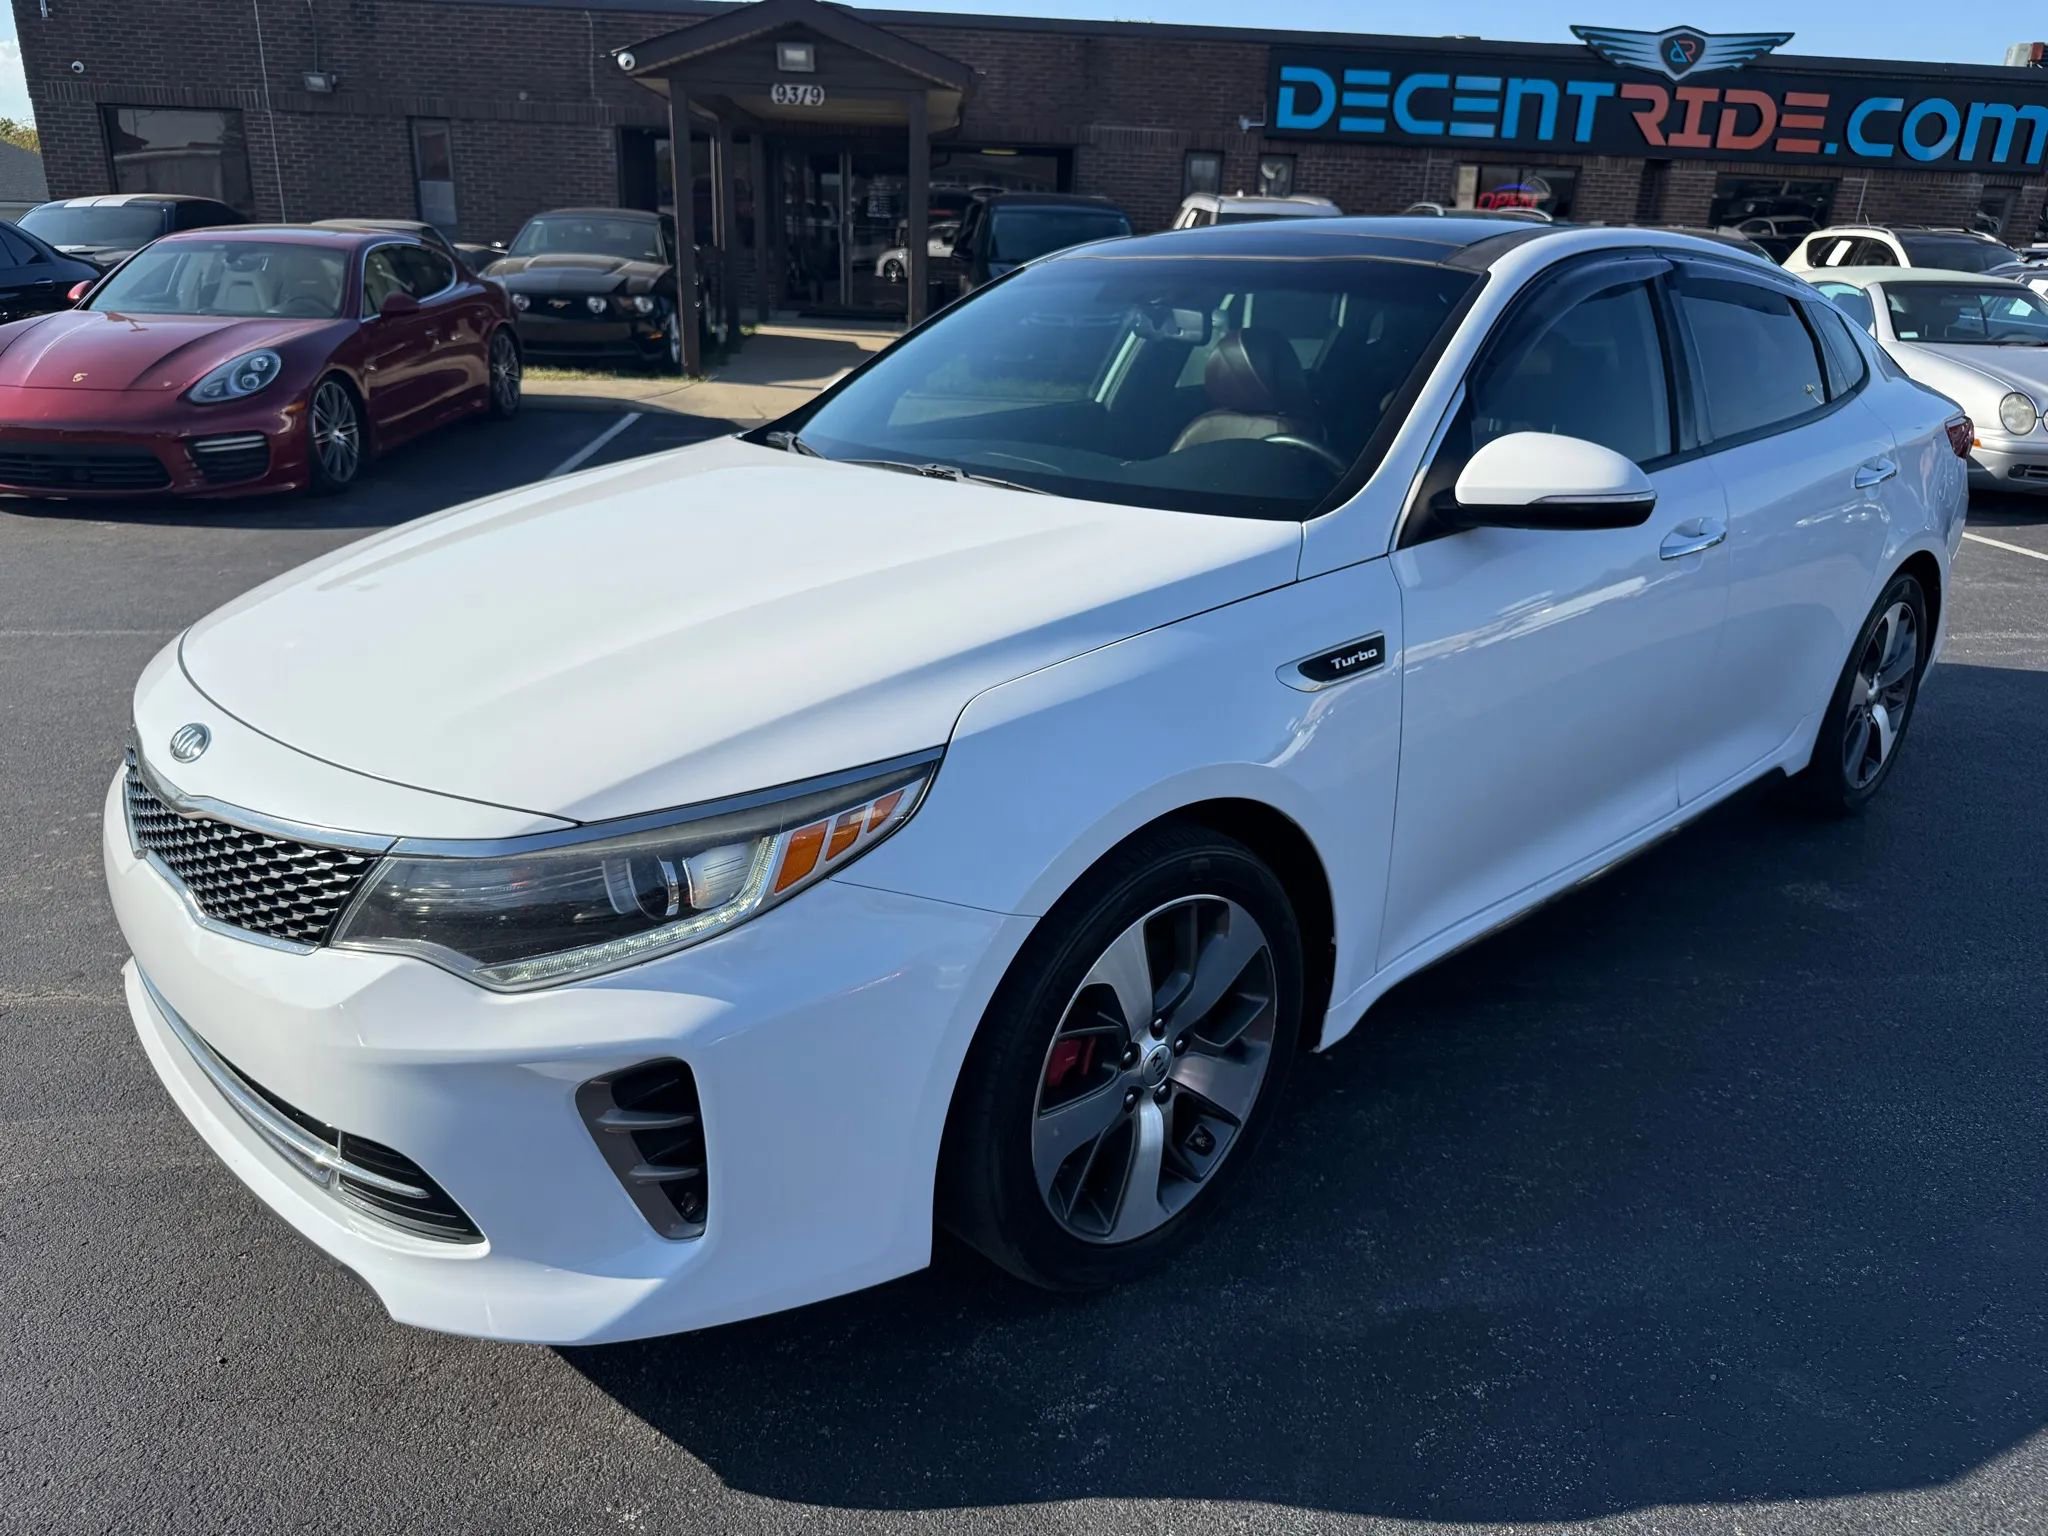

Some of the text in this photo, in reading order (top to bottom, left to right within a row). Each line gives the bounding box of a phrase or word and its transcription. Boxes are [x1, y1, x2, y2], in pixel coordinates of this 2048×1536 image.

[1477, 191, 1538, 210] OPEN
[1331, 648, 1378, 669] Turbo
[1151, 1052, 1167, 1078] KIA
